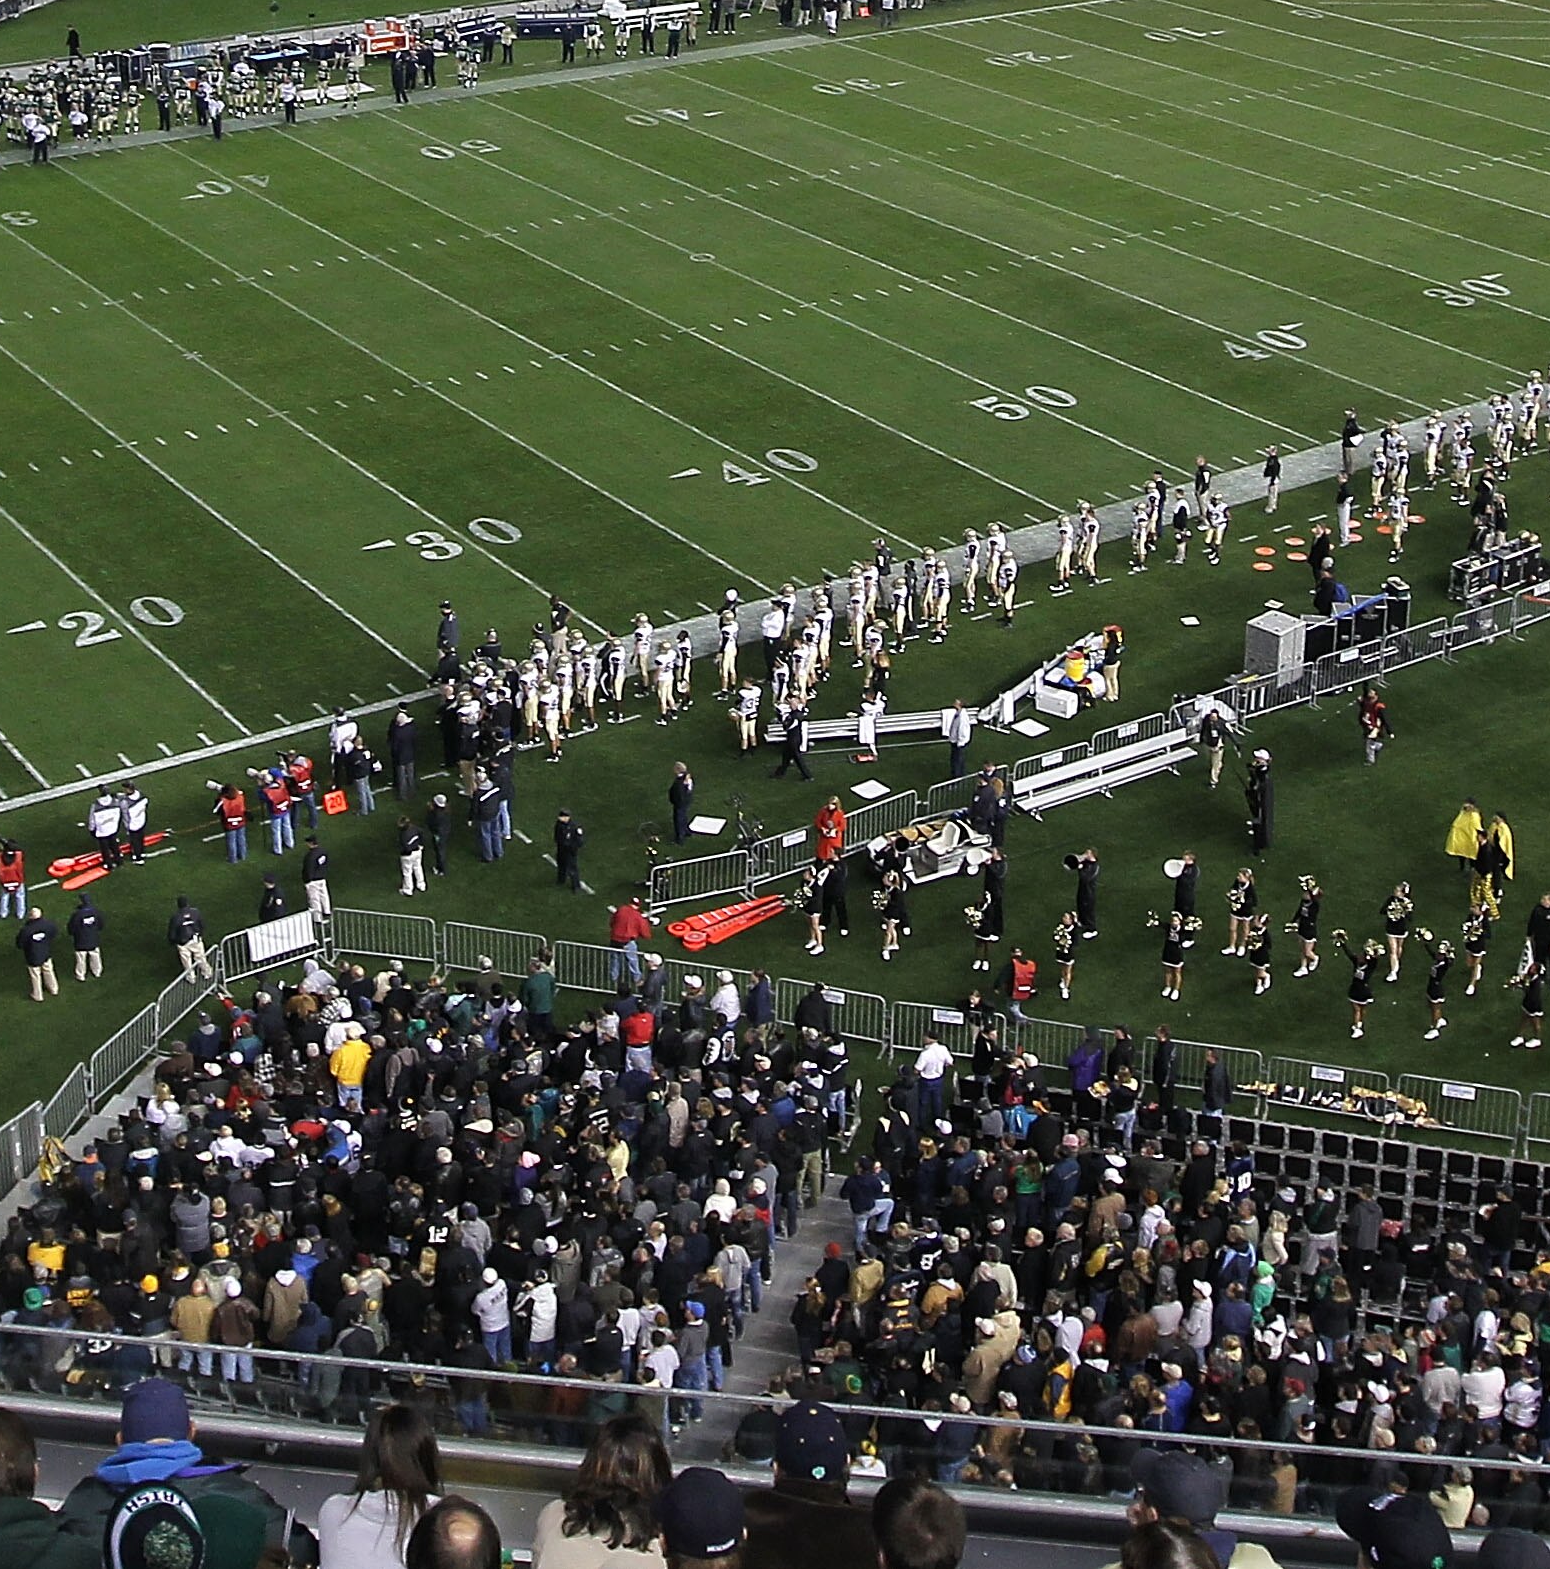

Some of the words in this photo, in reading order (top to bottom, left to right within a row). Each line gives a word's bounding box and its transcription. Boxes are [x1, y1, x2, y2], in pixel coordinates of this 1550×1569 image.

[1222, 328, 1309, 363] 40
[969, 384, 1079, 423] 50
[720, 446, 821, 490] 40
[405, 515, 524, 563] 30
[56, 594, 187, 651] 20
[428, 1225, 449, 1243] 12
